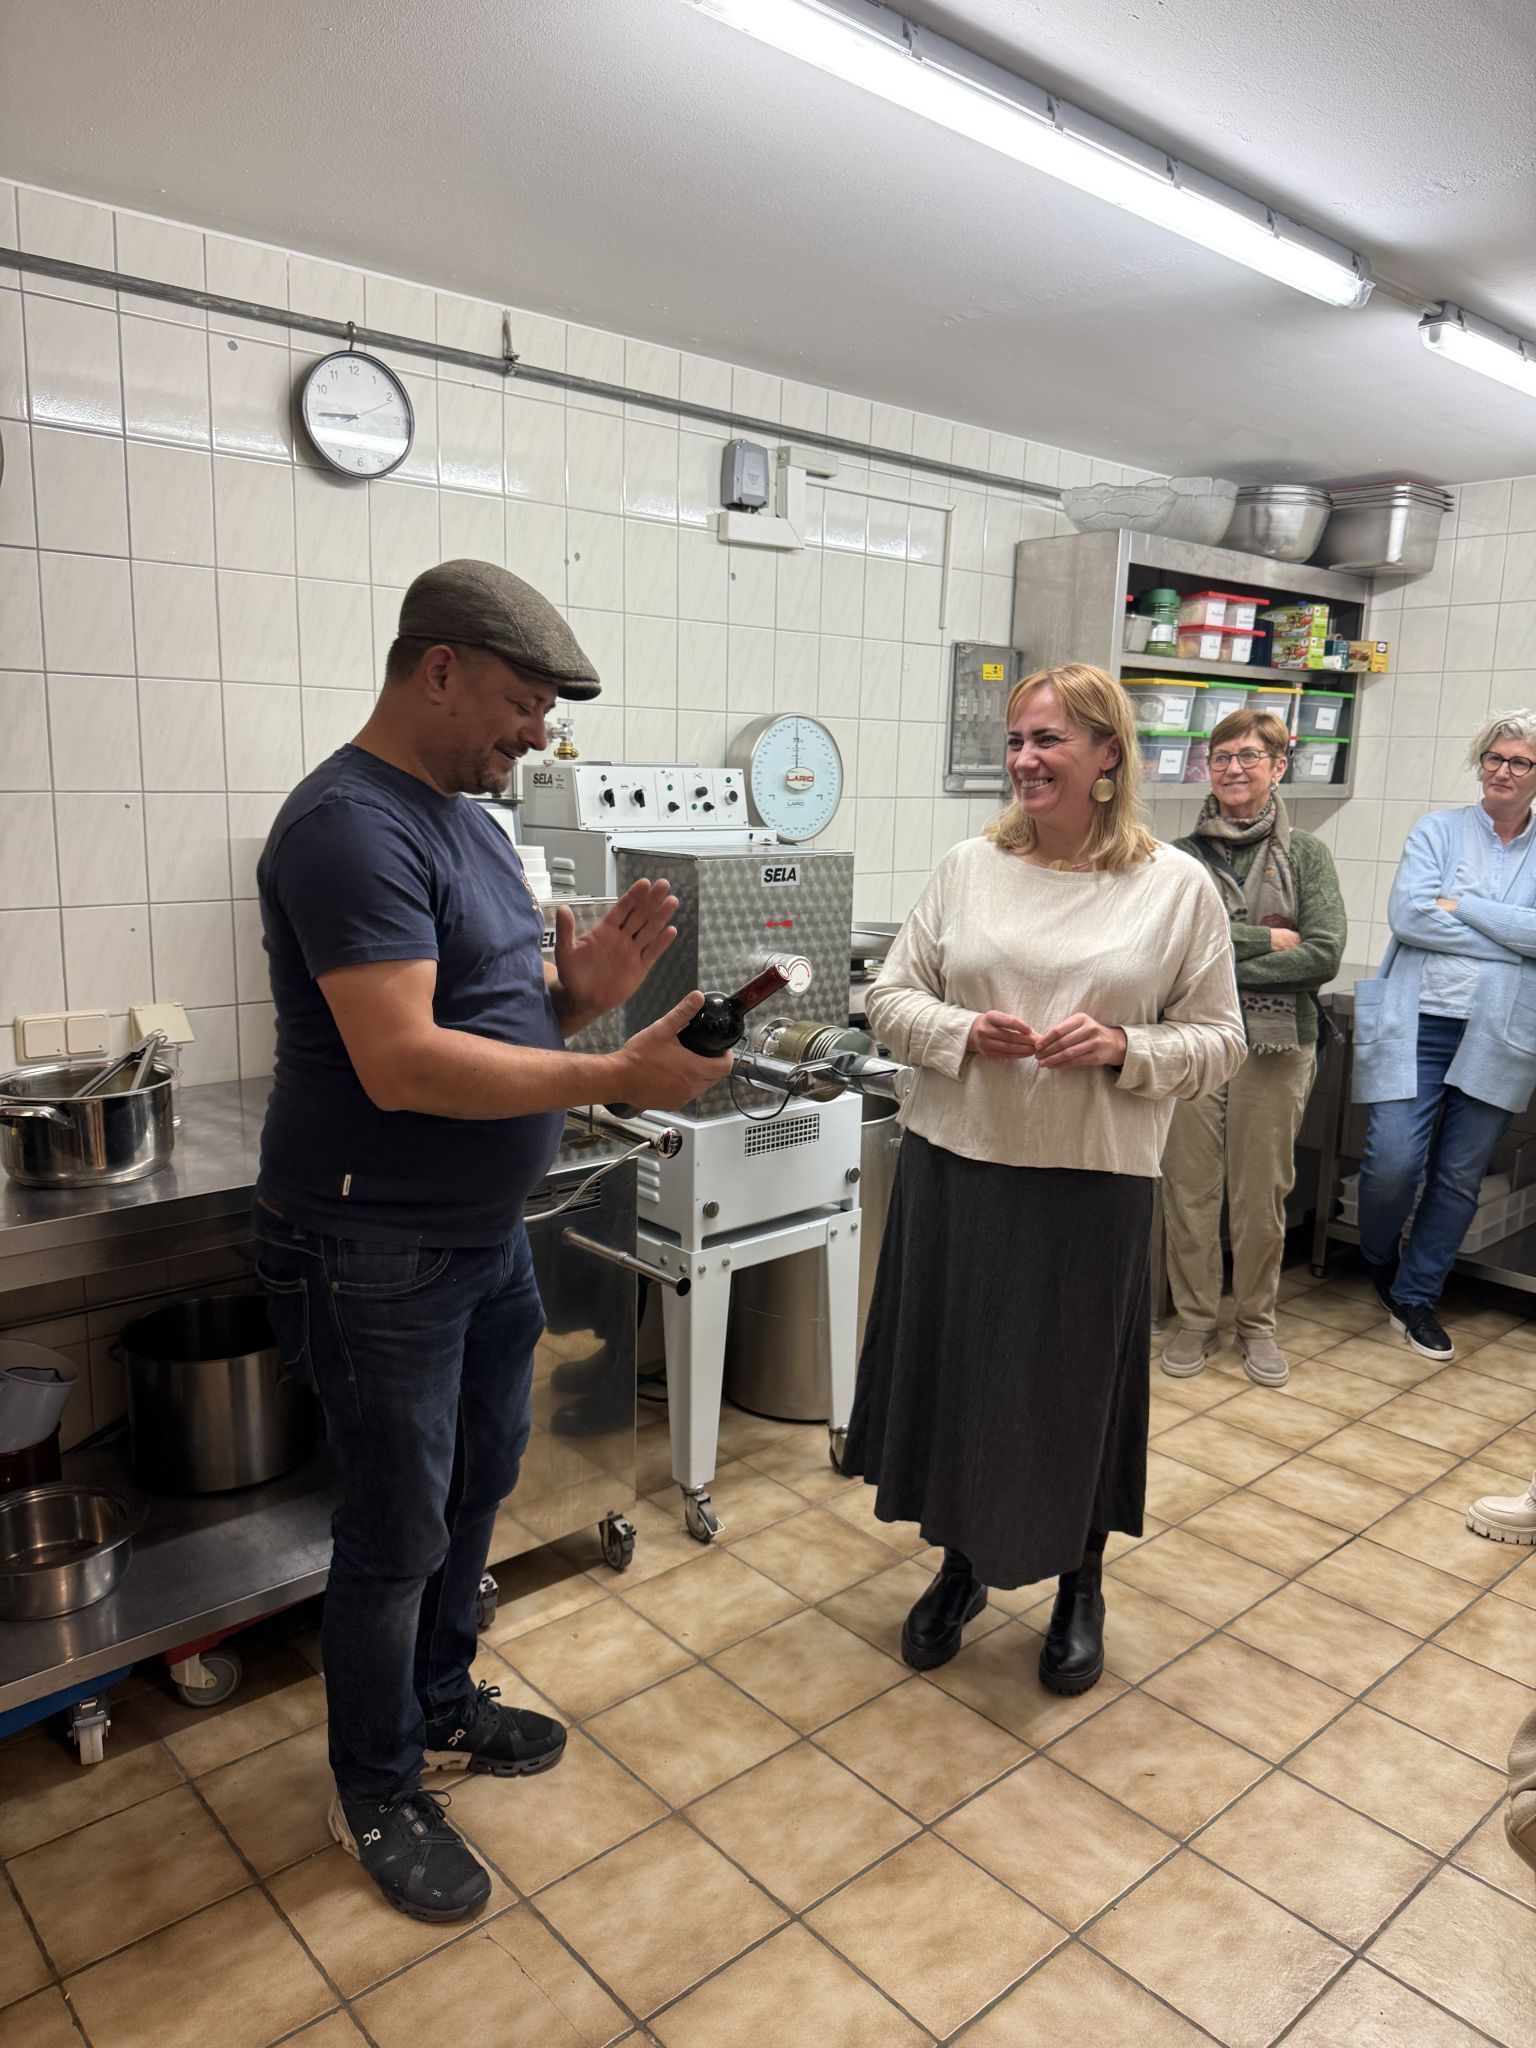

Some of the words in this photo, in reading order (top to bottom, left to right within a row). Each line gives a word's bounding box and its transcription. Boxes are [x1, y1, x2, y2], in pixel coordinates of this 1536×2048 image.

[330, 370, 339, 380] 11
[348, 365, 360, 376] 12
[317, 384, 328, 394] 10
[386, 392, 393, 402] 2
[393, 416, 400, 426] 3
[336, 449, 344, 459] 7
[357, 457, 364, 468] 6
[533, 773, 553, 785] SELA
[763, 867, 797, 883] SELA
[541, 931, 556, 948] EL
